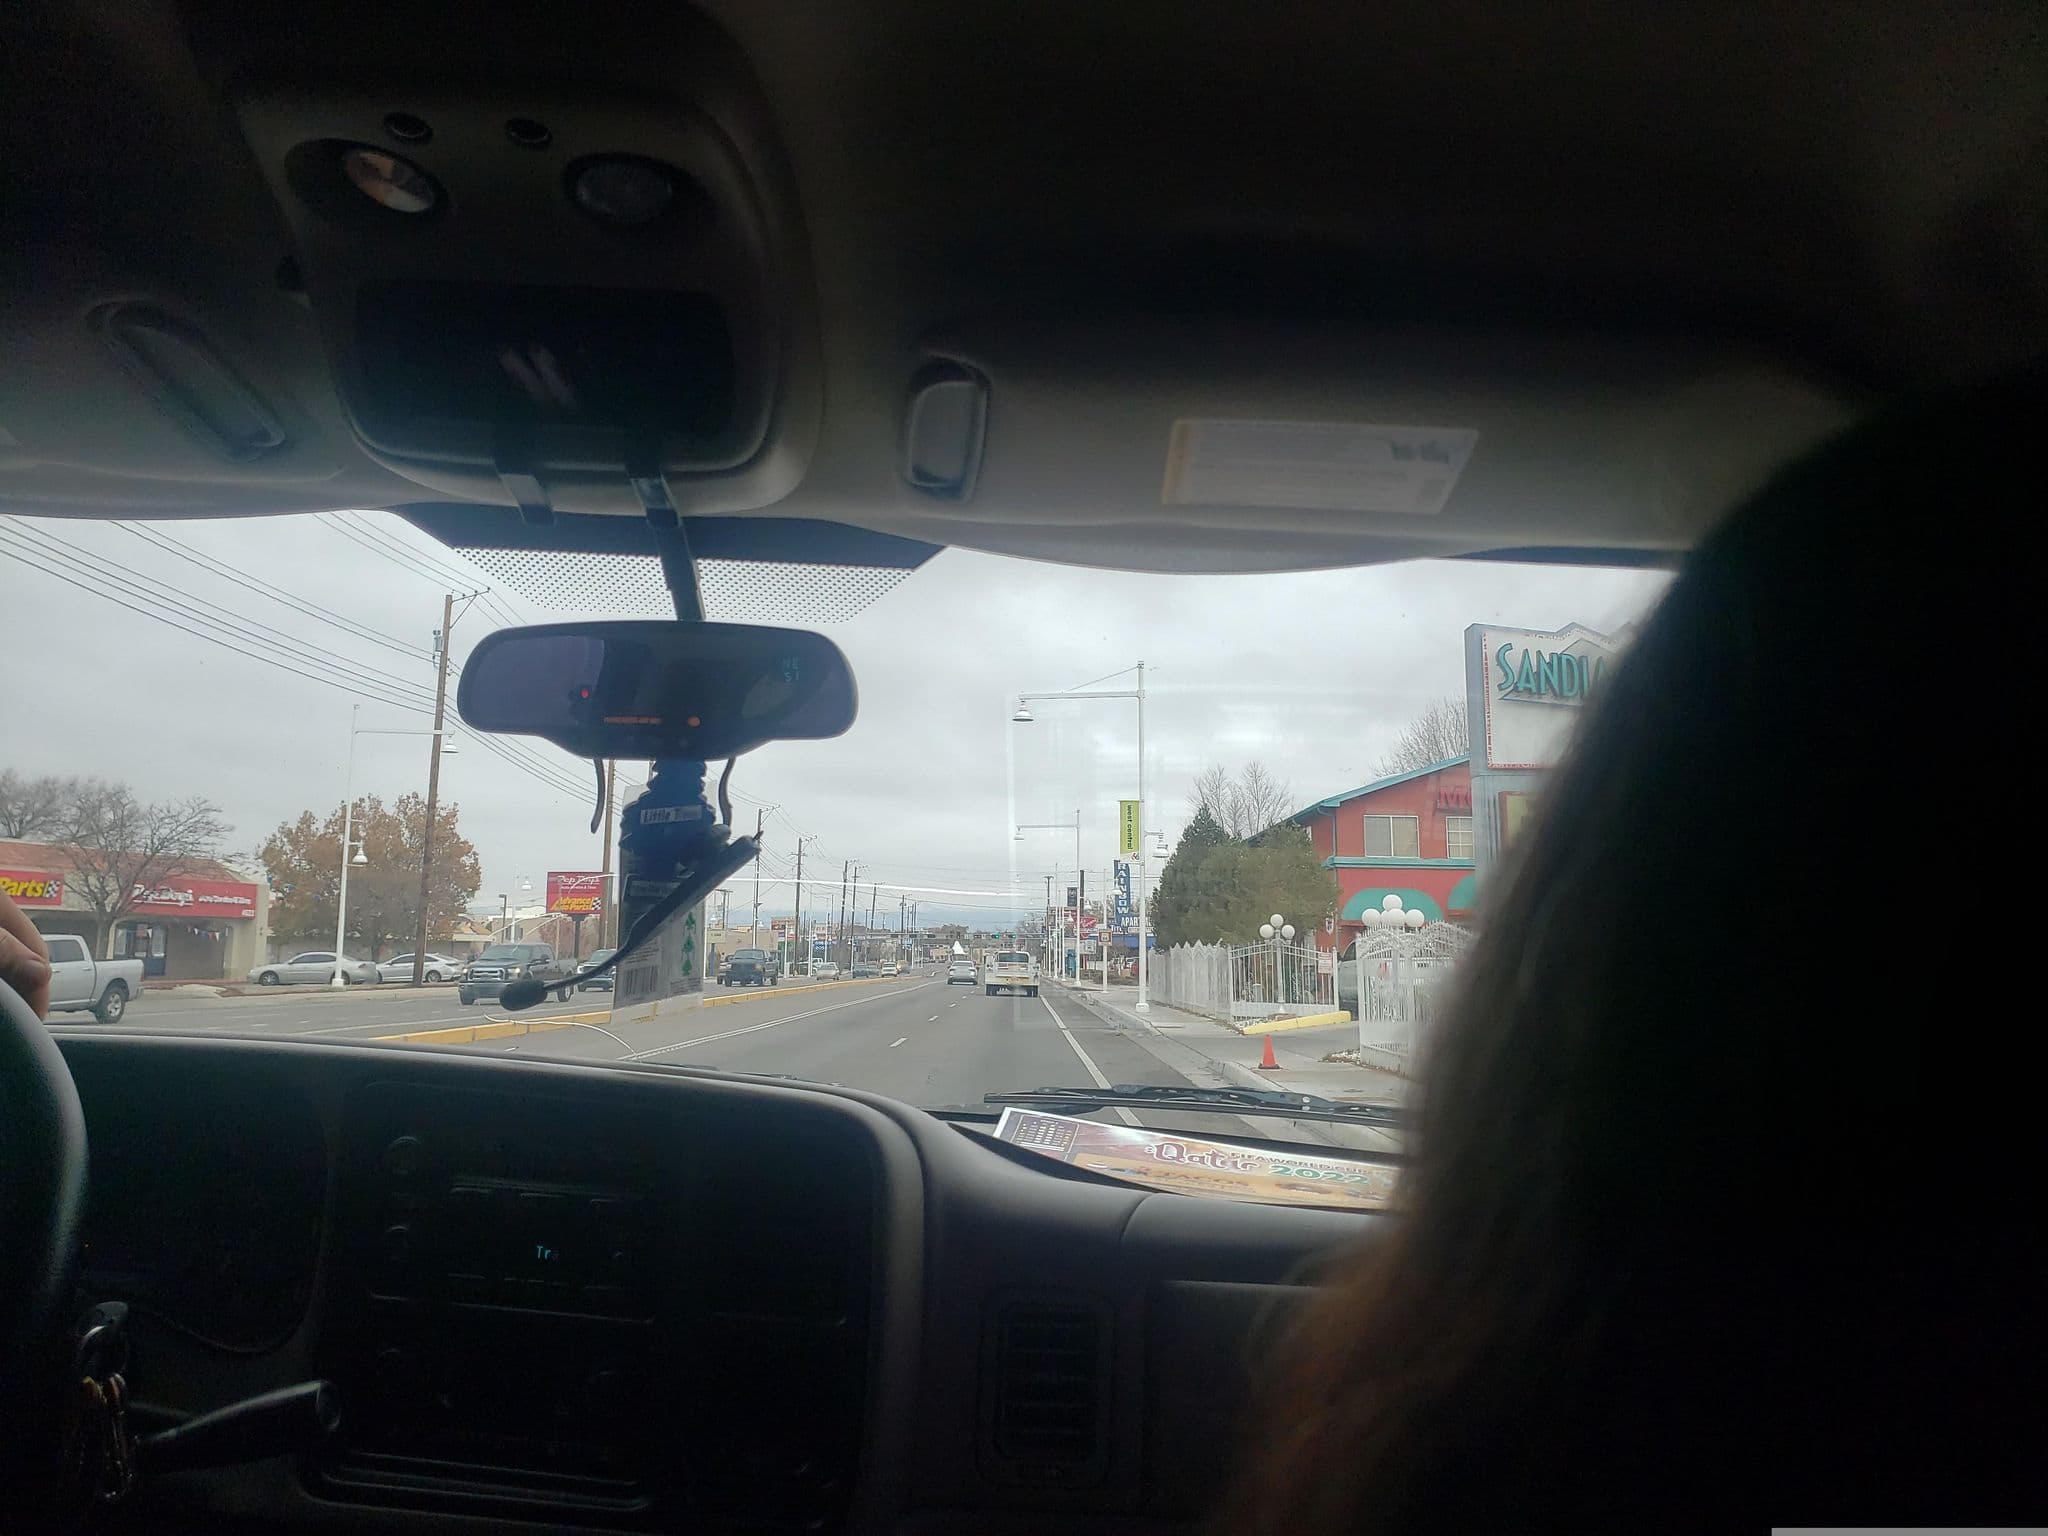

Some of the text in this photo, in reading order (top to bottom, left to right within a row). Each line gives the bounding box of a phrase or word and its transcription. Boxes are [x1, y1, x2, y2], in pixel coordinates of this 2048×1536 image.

[0, 877, 44, 897] Parts
[1153, 1142, 1261, 1172] Qatar
[1268, 1165, 1370, 1185] 2022
